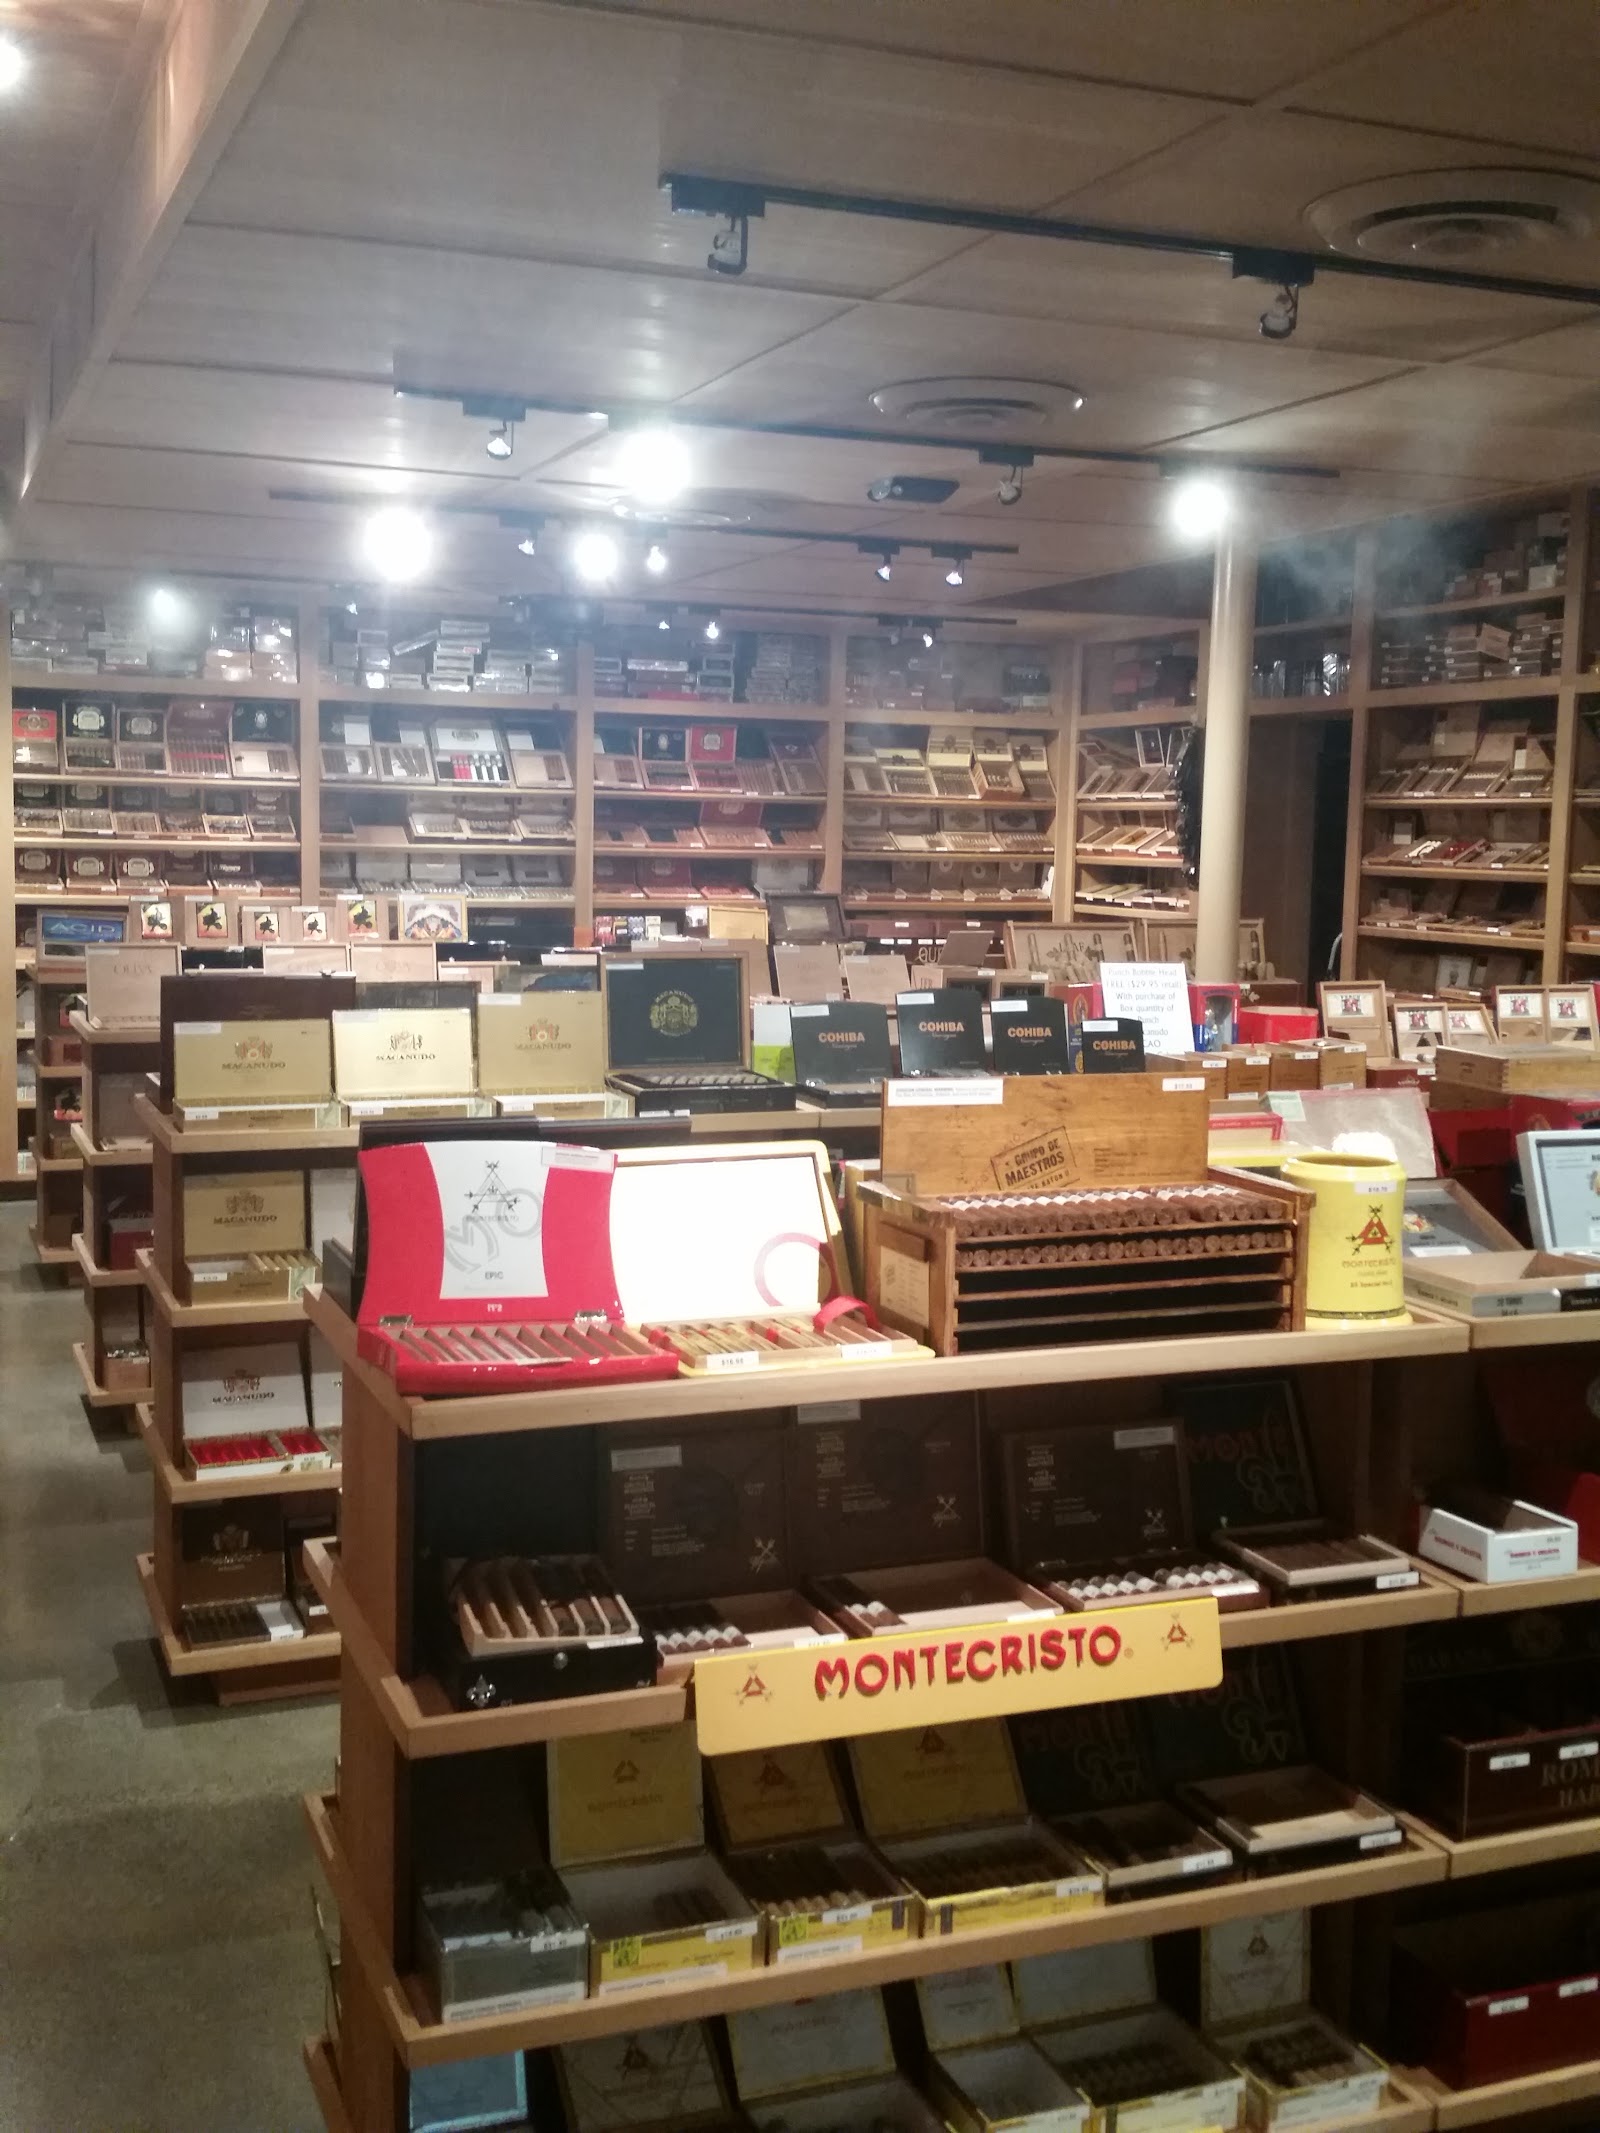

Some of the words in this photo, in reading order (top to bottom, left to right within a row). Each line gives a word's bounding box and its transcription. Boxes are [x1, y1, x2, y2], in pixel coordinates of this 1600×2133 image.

[1116, 992, 1133, 1000] With
[1135, 993, 1166, 1003] purchase
[1168, 992, 1176, 1000] of
[1120, 1004, 1133, 1012] Box
[1136, 1004, 1165, 1014] quantity
[1167, 1004, 1174, 1012] of
[918, 1020, 965, 1032] COHIBA
[818, 1031, 866, 1044] COHIBA
[1007, 1026, 1053, 1038] COHIBA
[1092, 1040, 1137, 1051] COHIBA
[375, 1053, 437, 1061] MACANUDO
[221, 1061, 286, 1070] MACANUDO
[1014, 1145, 1046, 1167] GRUPO
[1046, 1137, 1061, 1151] DE
[1004, 1151, 1066, 1187] MAESTROS
[213, 1214, 278, 1224] MACANUDO
[485, 1271, 504, 1280] EPIC
[814, 1624, 1123, 1701] MONTECRISTO
